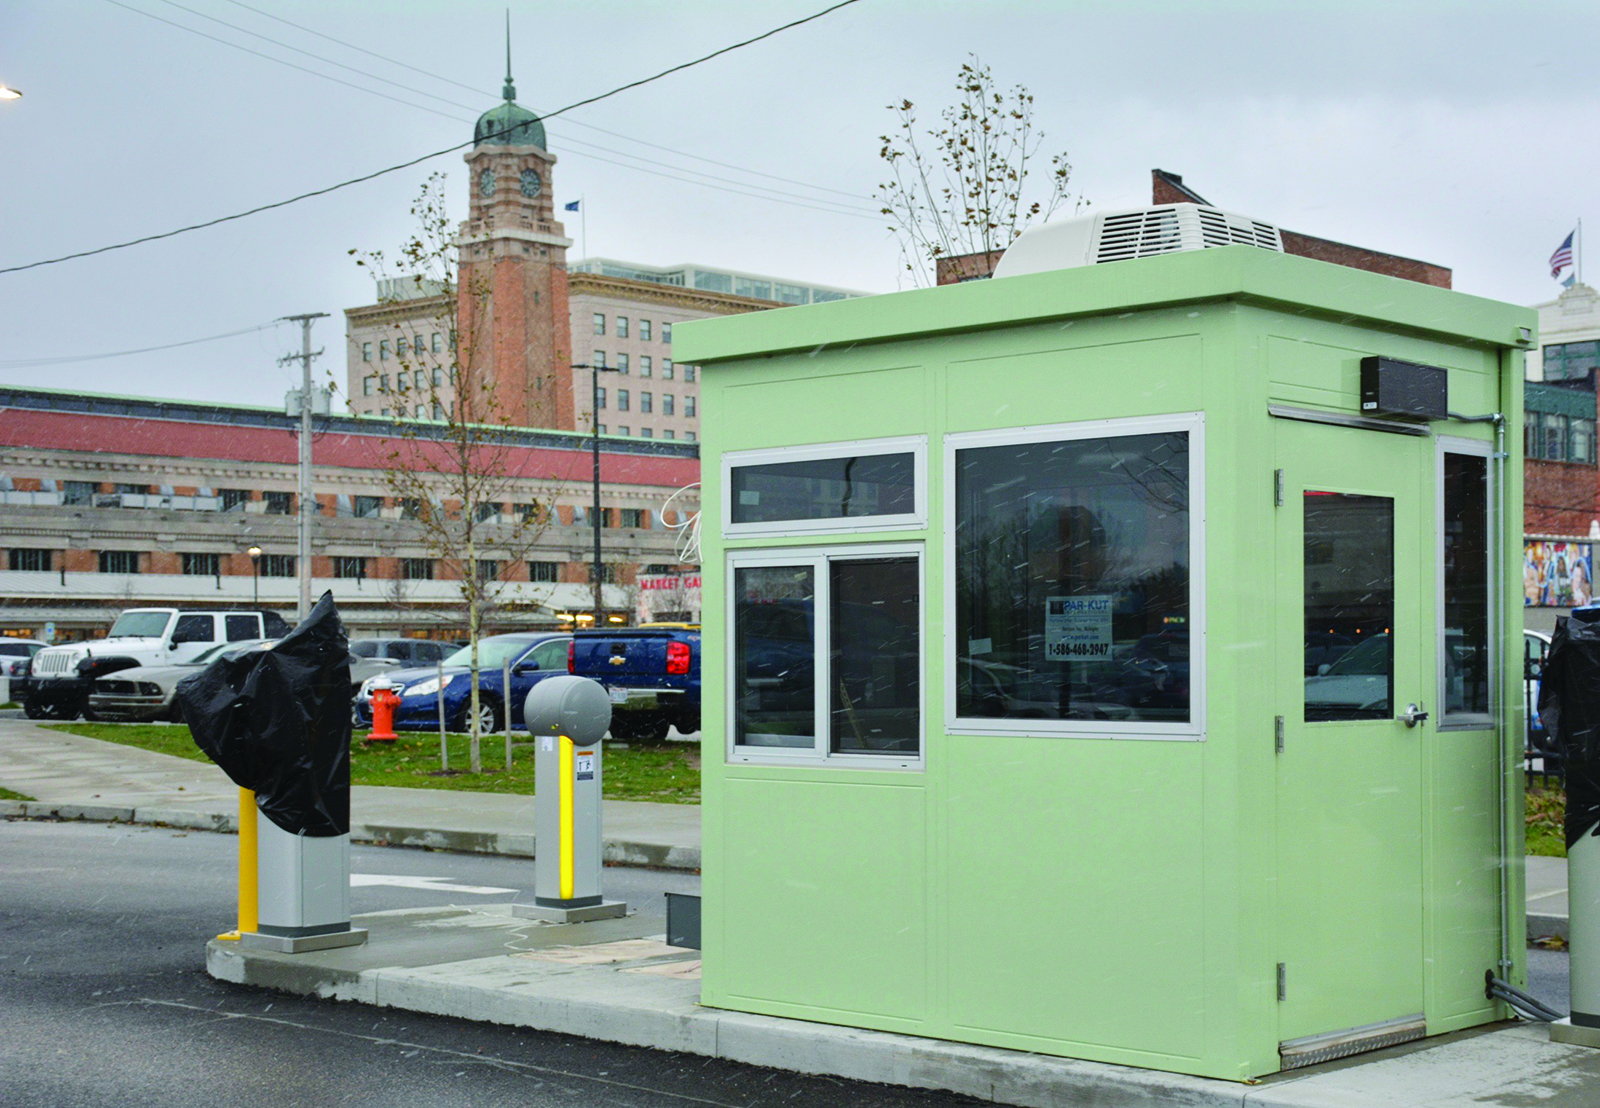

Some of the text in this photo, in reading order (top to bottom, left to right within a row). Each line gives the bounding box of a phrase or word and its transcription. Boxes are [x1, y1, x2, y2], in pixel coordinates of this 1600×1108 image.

[641, 577, 679, 590] MARKET
[1064, 600, 1109, 611] PAR-KUT
[1049, 643, 1109, 656] 1-586-468-2947
